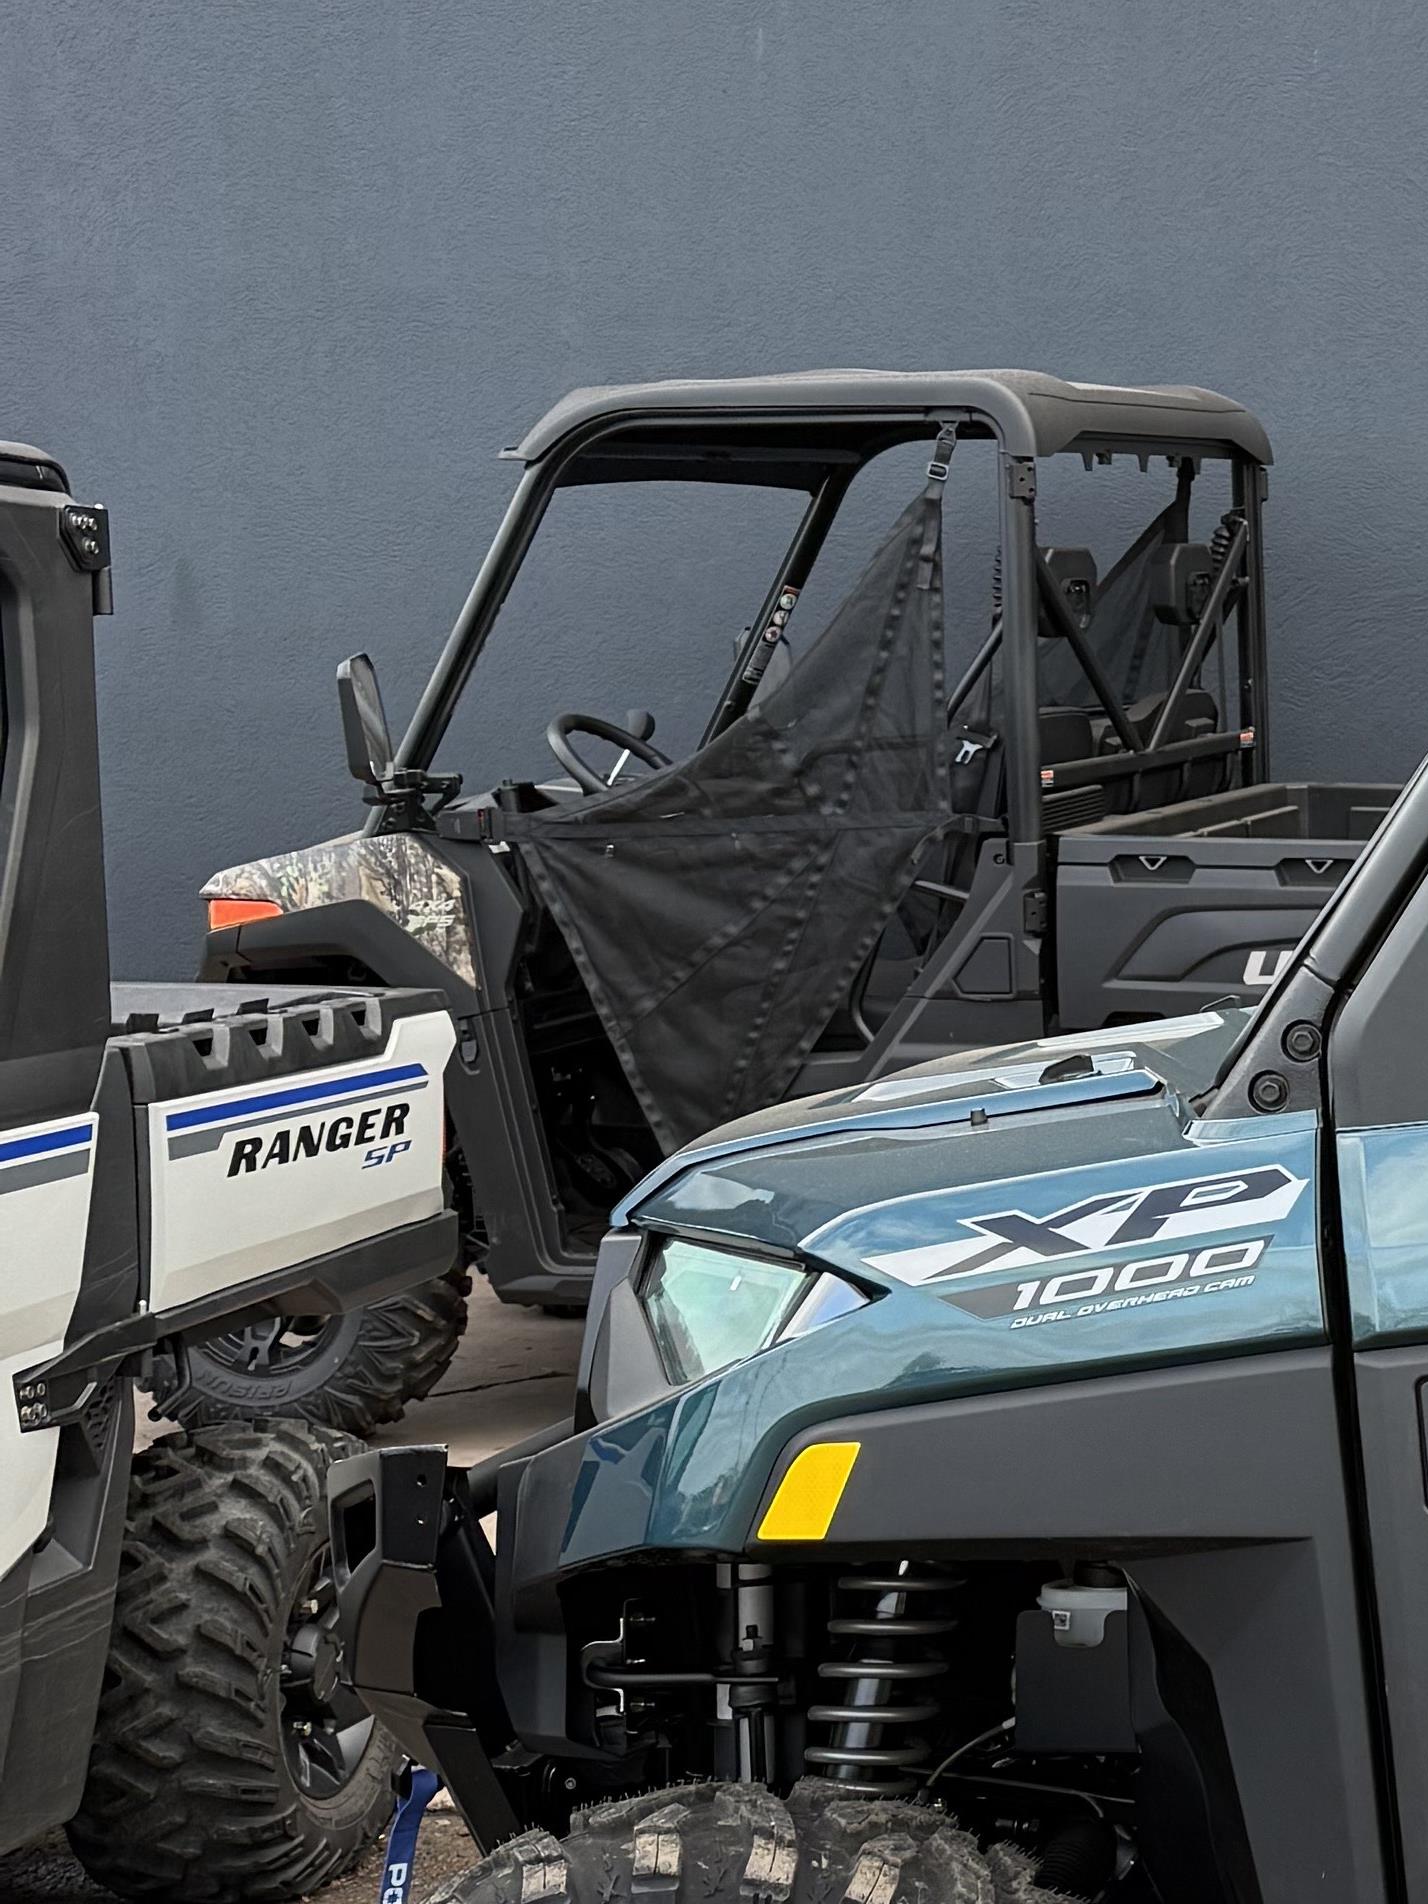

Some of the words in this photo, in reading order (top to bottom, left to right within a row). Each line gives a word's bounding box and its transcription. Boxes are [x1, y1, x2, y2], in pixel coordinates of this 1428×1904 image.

[226, 1102, 410, 1178] RANGER
[360, 1139, 412, 1170] SP
[919, 1166, 1296, 1281] XP
[1009, 1310, 1072, 1330] DUAL
[1077, 1284, 1199, 1316] OVERHEAD
[1203, 1274, 1256, 1294] CAM
[1012, 1239, 1265, 1310] 1000
